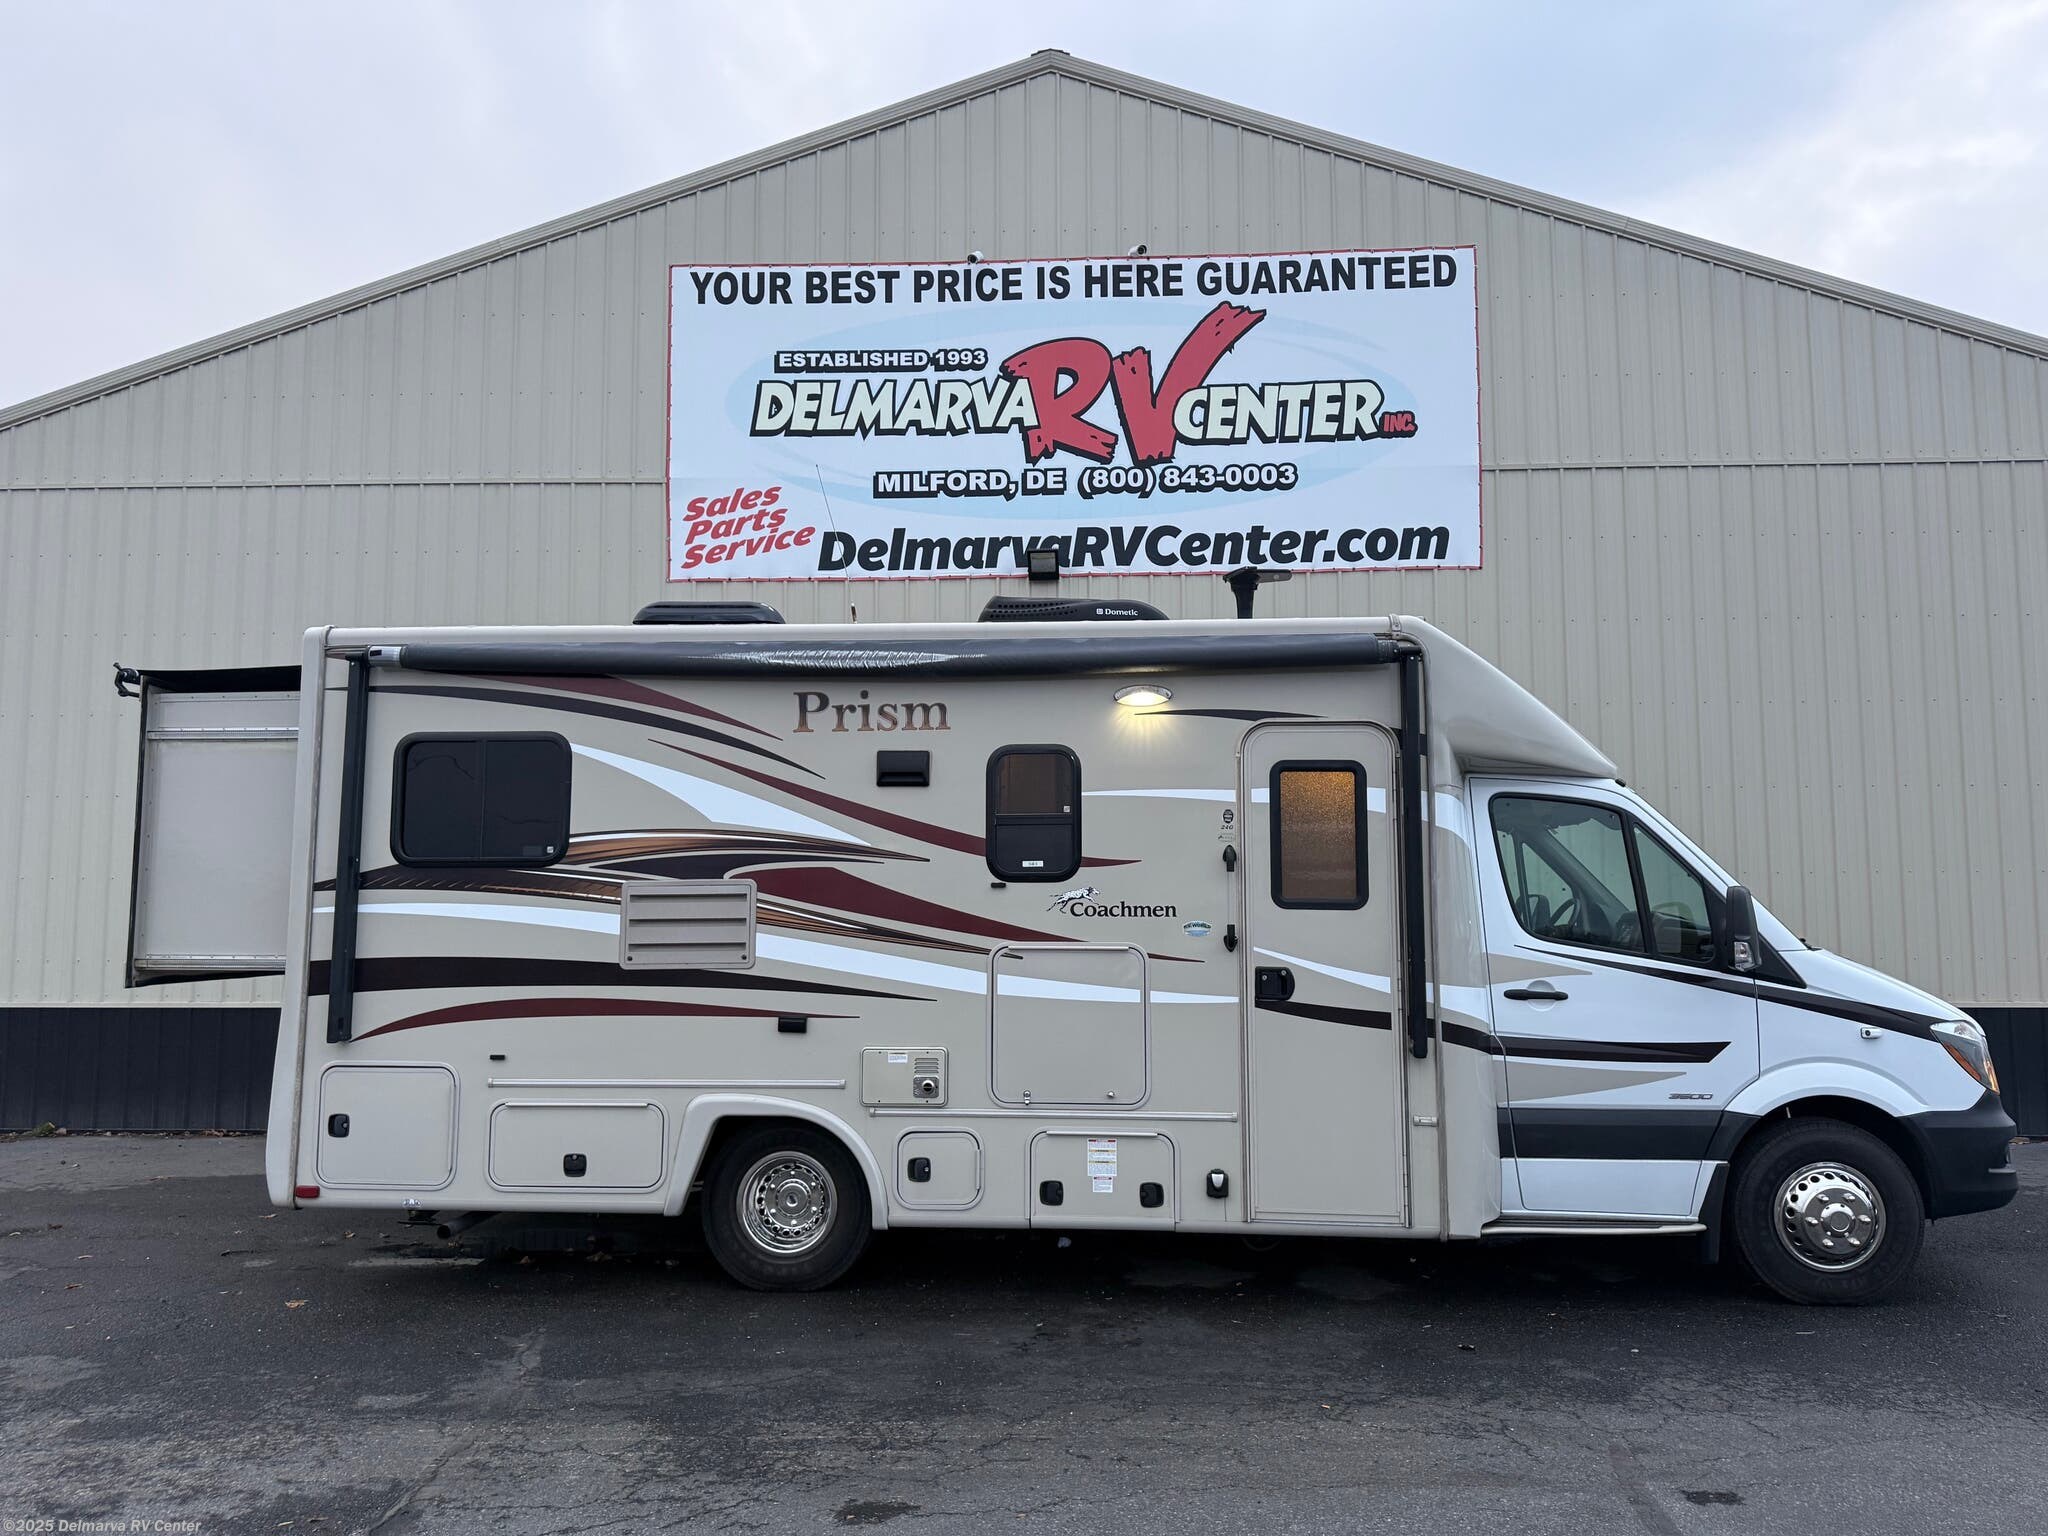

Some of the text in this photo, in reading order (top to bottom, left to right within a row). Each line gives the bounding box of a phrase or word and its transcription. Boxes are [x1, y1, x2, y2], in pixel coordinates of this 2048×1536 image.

[690, 254, 1457, 305] YOUR BEST PRICE IS HERE GUARANTEED
[777, 349, 987, 370] ESTABLISHED 1993
[752, 378, 1041, 436] DELMARVA
[1002, 301, 1267, 465] RV
[1173, 380, 1383, 443] CENTER
[876, 464, 1297, 495] MILFORD, DE (800) 843-0003
[683, 486, 782, 522] Sales
[685, 508, 788, 546] Parts
[681, 526, 816, 570] Service
[818, 525, 1450, 571] DelmarvaRVCenter.com
[1105, 608, 1139, 617] Dometic
[793, 689, 951, 734] Prism
[1070, 901, 1177, 917] Coachmen
